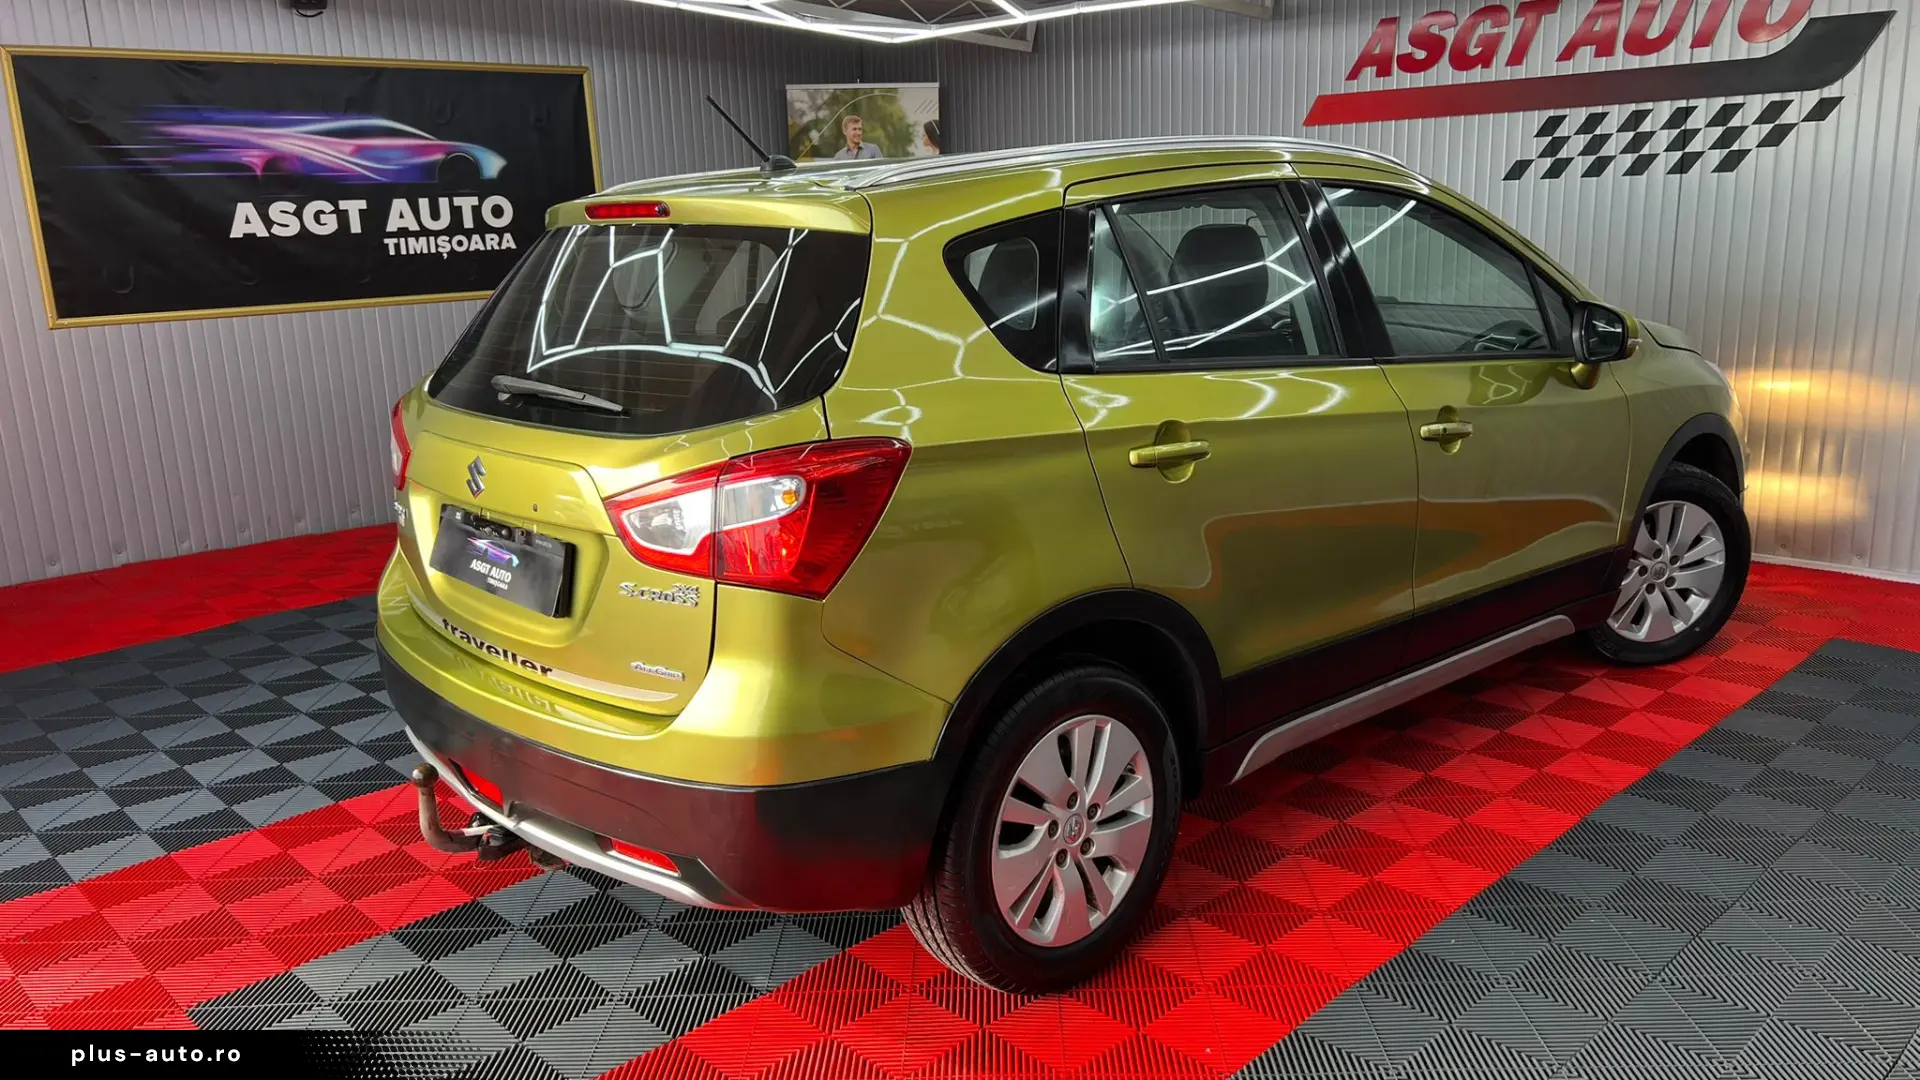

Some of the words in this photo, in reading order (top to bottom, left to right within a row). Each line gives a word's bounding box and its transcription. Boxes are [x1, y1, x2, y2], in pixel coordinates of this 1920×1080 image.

[1345, 0, 1559, 81] ASGT
[229, 199, 368, 239] ASGT
[386, 195, 514, 233] AUTO
[383, 233, 517, 260] TIMIȘOARA
[470, 558, 491, 575] ASGT
[489, 566, 512, 583] AUTO
[442, 618, 553, 677] traveller
